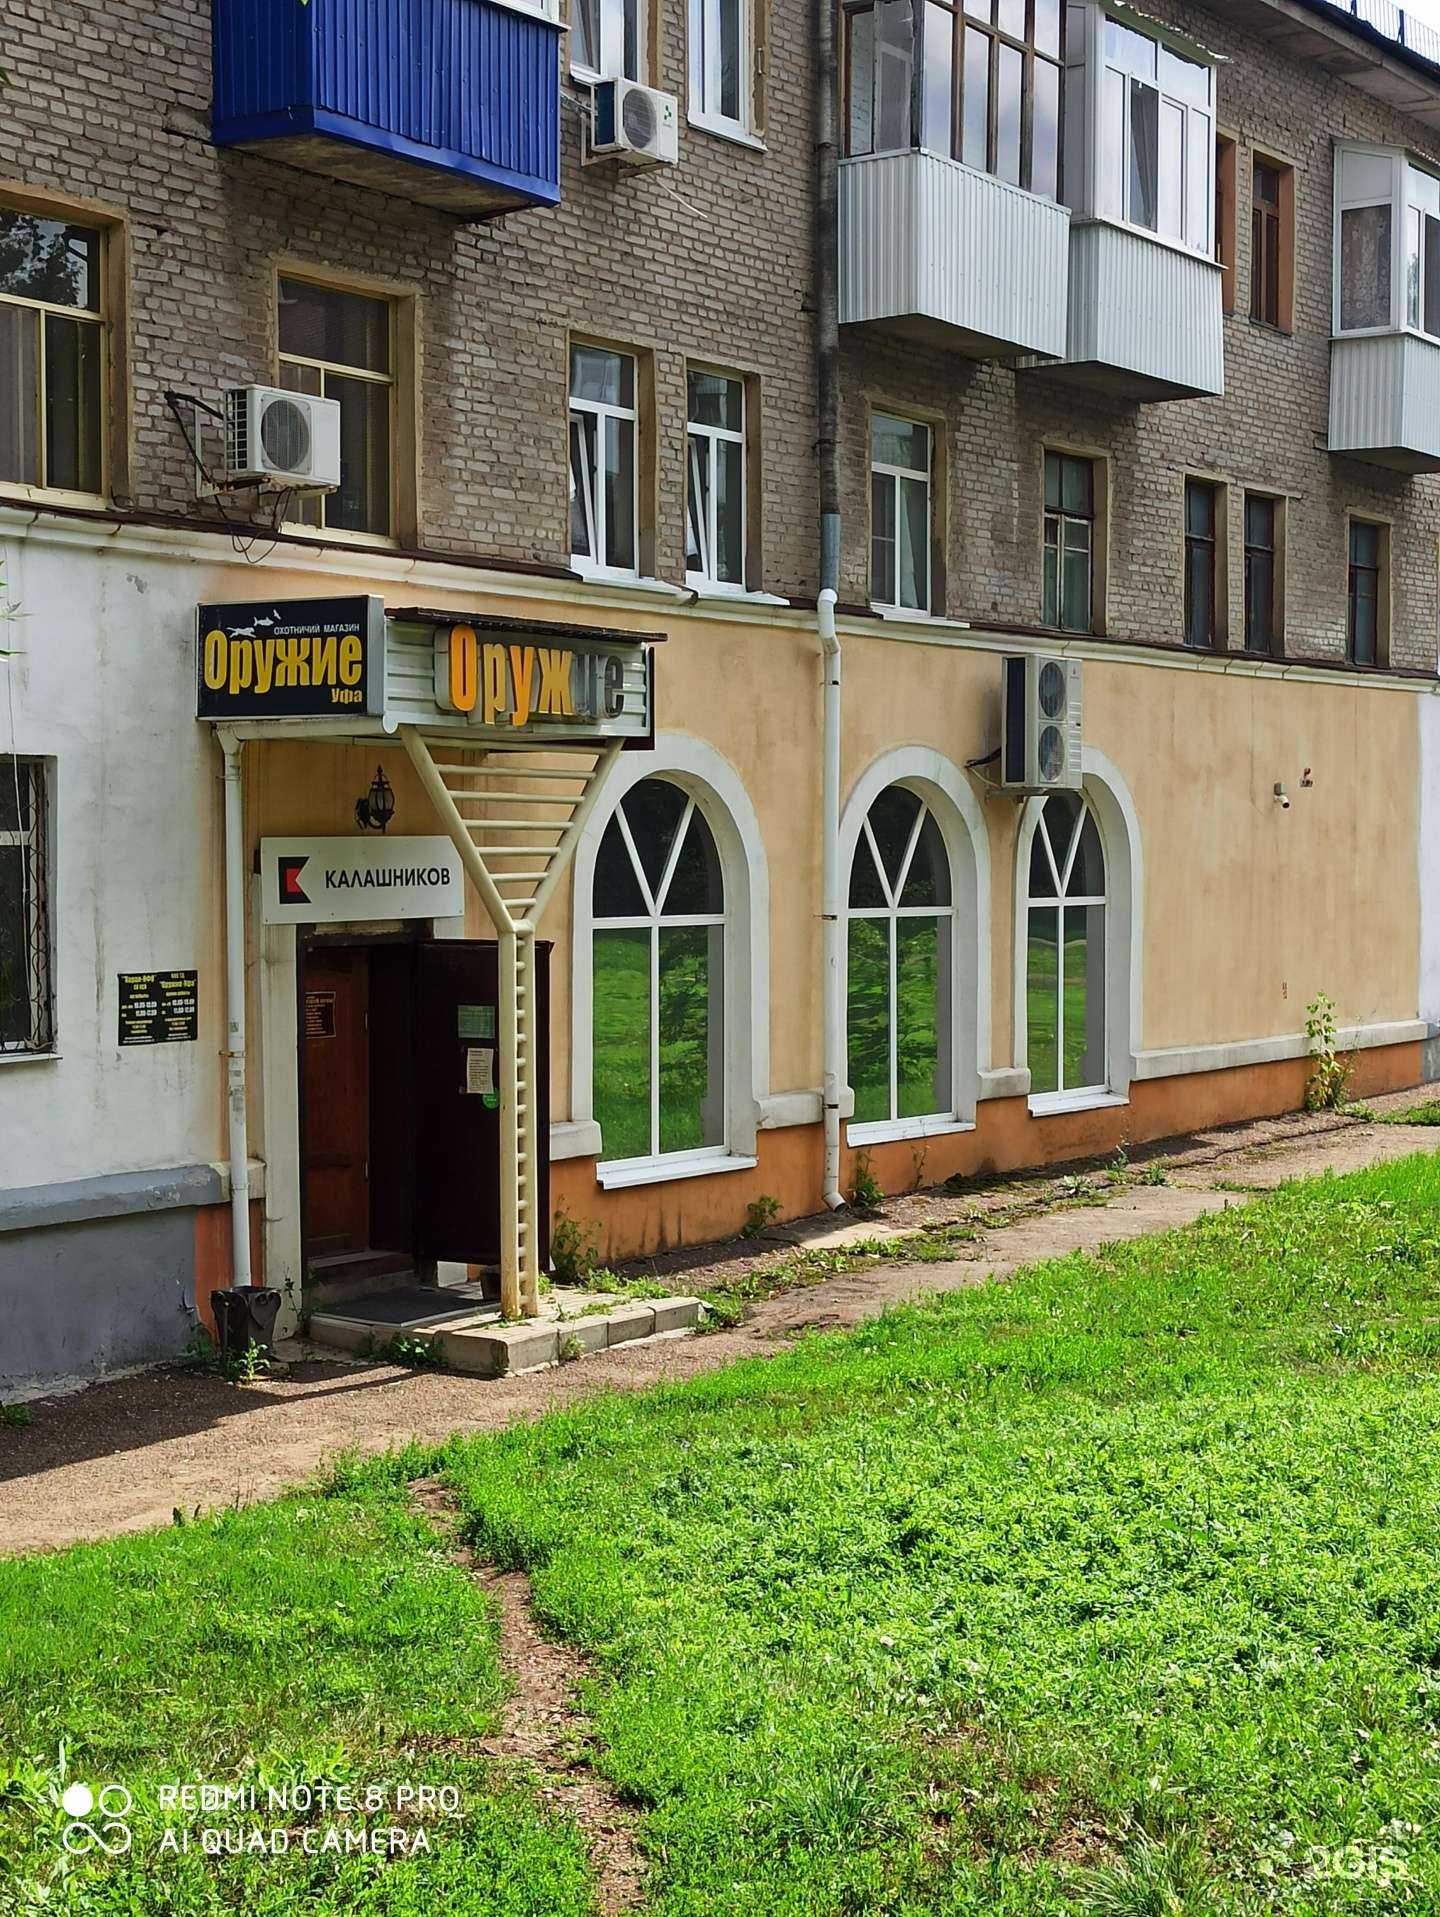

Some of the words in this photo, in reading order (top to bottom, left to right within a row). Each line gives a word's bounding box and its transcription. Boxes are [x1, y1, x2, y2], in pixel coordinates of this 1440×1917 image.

[273, 625, 320, 635] ОХОТНИЧИЙ
[323, 621, 360, 633] МАГАЗИН
[203, 630, 363, 695] Оружие
[331, 687, 363, 704] Уфа
[325, 867, 451, 889] КАЛАШНИКОВ
